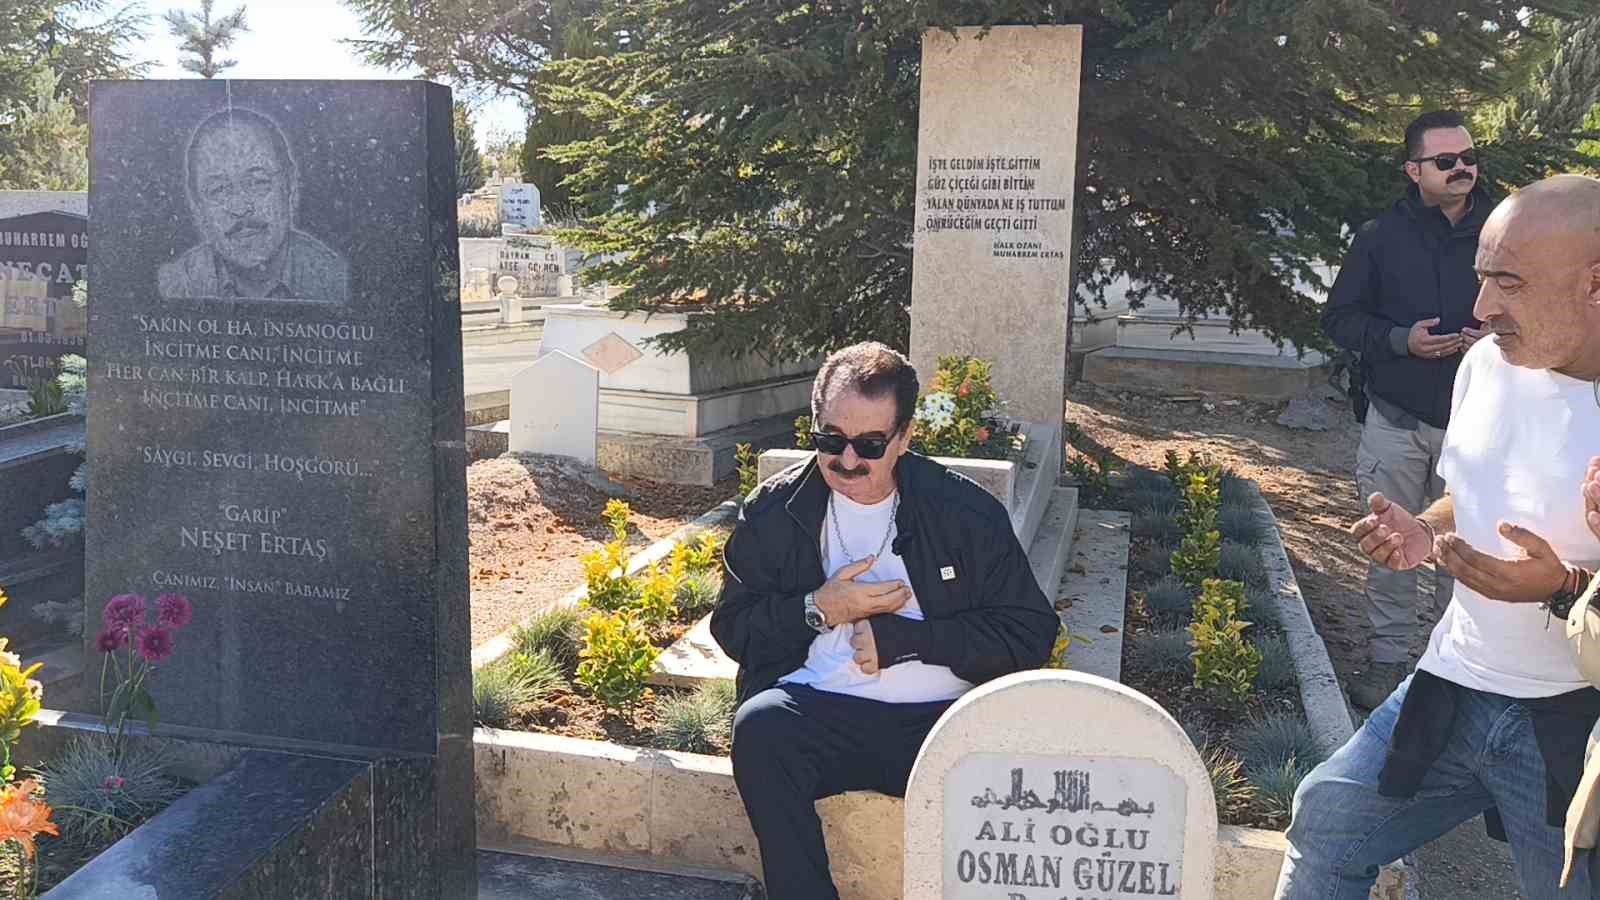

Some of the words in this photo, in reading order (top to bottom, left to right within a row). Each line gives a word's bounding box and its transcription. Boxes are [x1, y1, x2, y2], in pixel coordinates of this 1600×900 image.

[950, 156, 984, 170] GELDİM
[1008, 156, 1041, 170] GİTTİM
[927, 198, 954, 210] YALAN
[1002, 198, 1014, 210] NE
[1028, 198, 1065, 211] TUTTUM
[198, 318, 220, 333] OL
[264, 320, 374, 341] İNSANOĞLU
[144, 339, 221, 360] İNCİTME
[282, 344, 363, 367] İNCİTME
[105, 363, 142, 380] HER
[148, 366, 184, 383] CAN
[191, 365, 220, 385] BİR
[351, 373, 405, 394] BAĞLI
[180, 527, 251, 556] NEŞET
[260, 532, 328, 561] ERTAŞ
[285, 582, 351, 601] BABAMIZ
[975, 818, 1036, 843] ALİ
[1050, 823, 1150, 850] OĞLU
[957, 850, 1063, 888] OSMAN
[1073, 852, 1176, 895] GÜZEL
